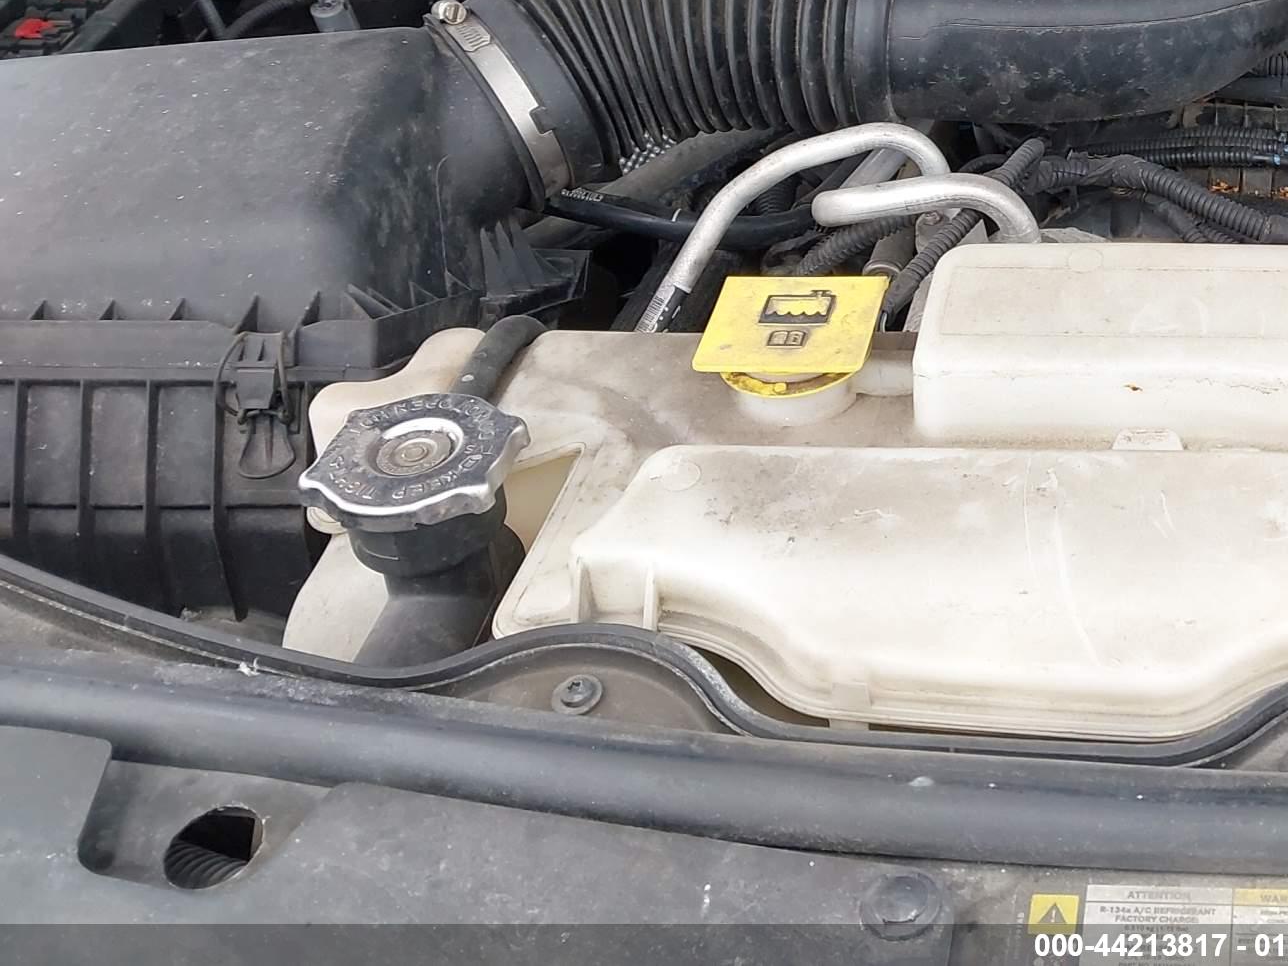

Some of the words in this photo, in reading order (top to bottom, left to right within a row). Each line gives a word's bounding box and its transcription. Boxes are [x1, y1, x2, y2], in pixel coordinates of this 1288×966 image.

[1127, 890, 1191, 900] ATTENTION
[1100, 905, 1131, 914] R-134a
[1133, 907, 1152, 915] A/C
[1154, 906, 1217, 916] REFRIGERANT
[1115, 914, 1157, 923] FACTORY
